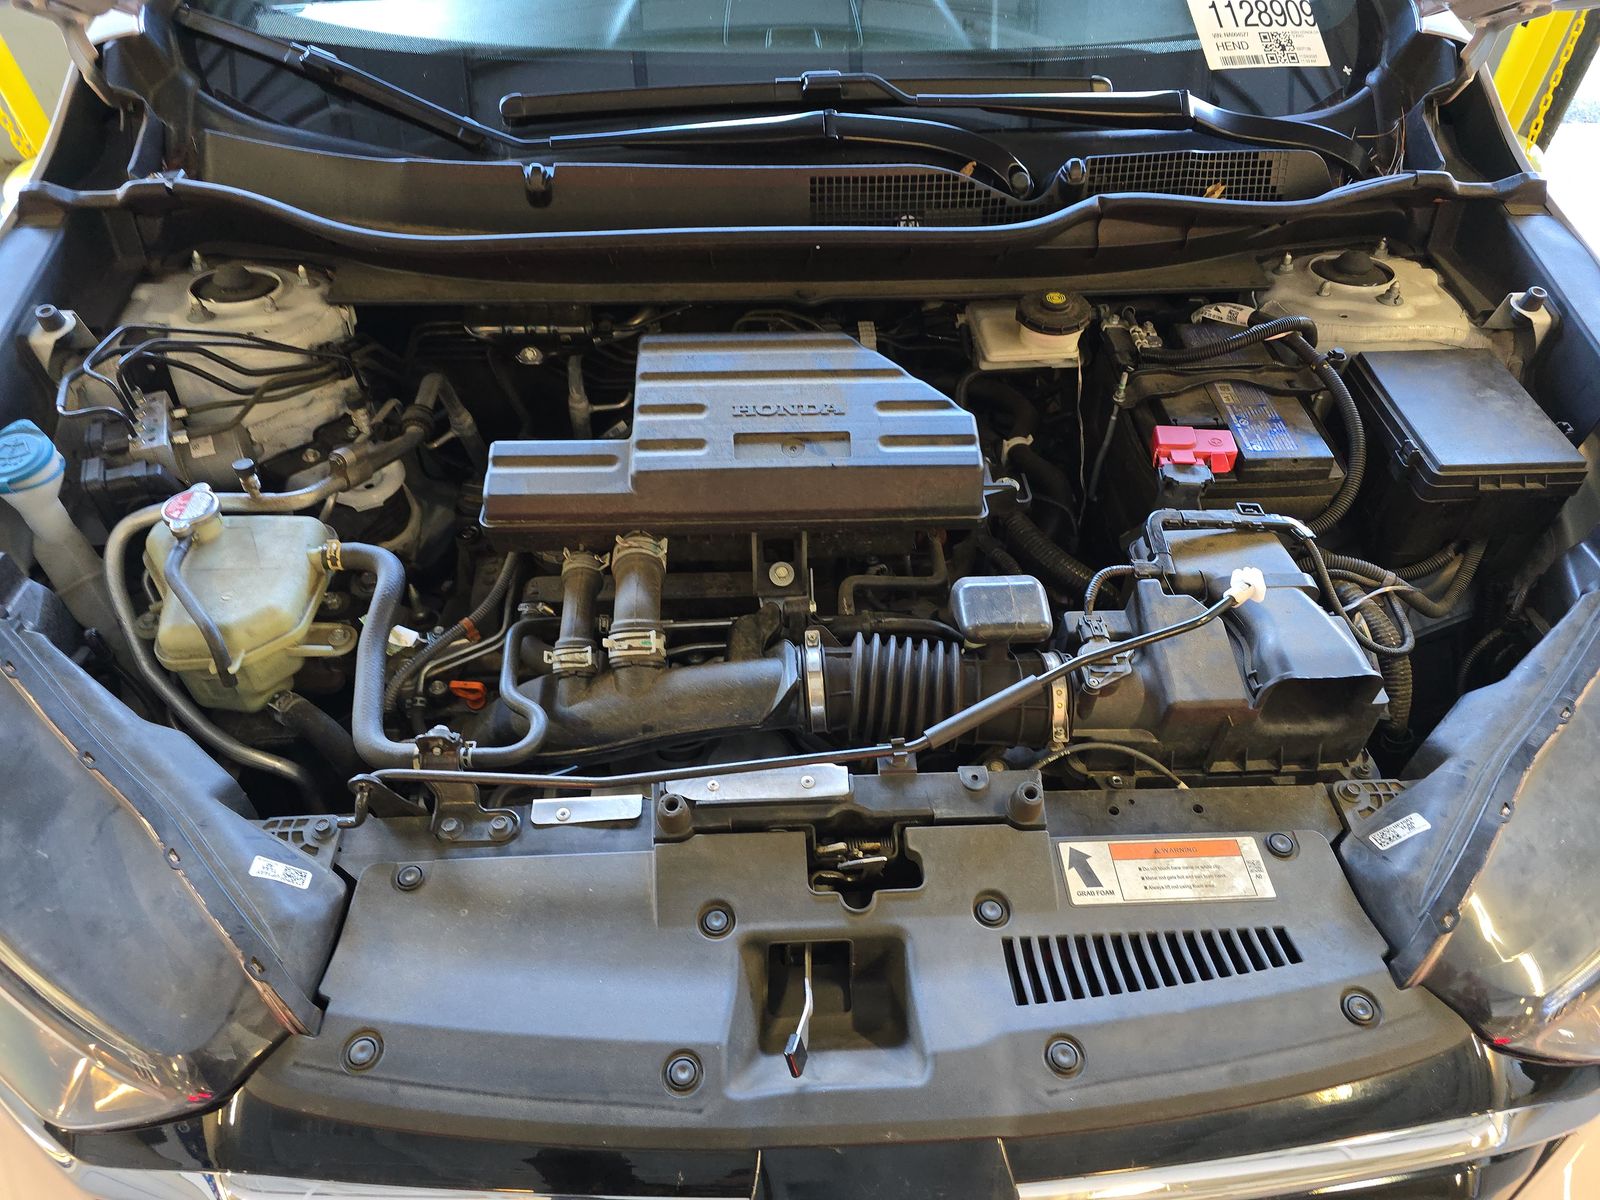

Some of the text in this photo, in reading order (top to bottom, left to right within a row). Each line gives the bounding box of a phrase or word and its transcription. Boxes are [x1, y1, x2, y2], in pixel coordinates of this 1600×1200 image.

[1208, 0, 1317, 28] 1128909
[1215, 40, 1250, 51] HEND
[732, 403, 846, 417] HONDA
